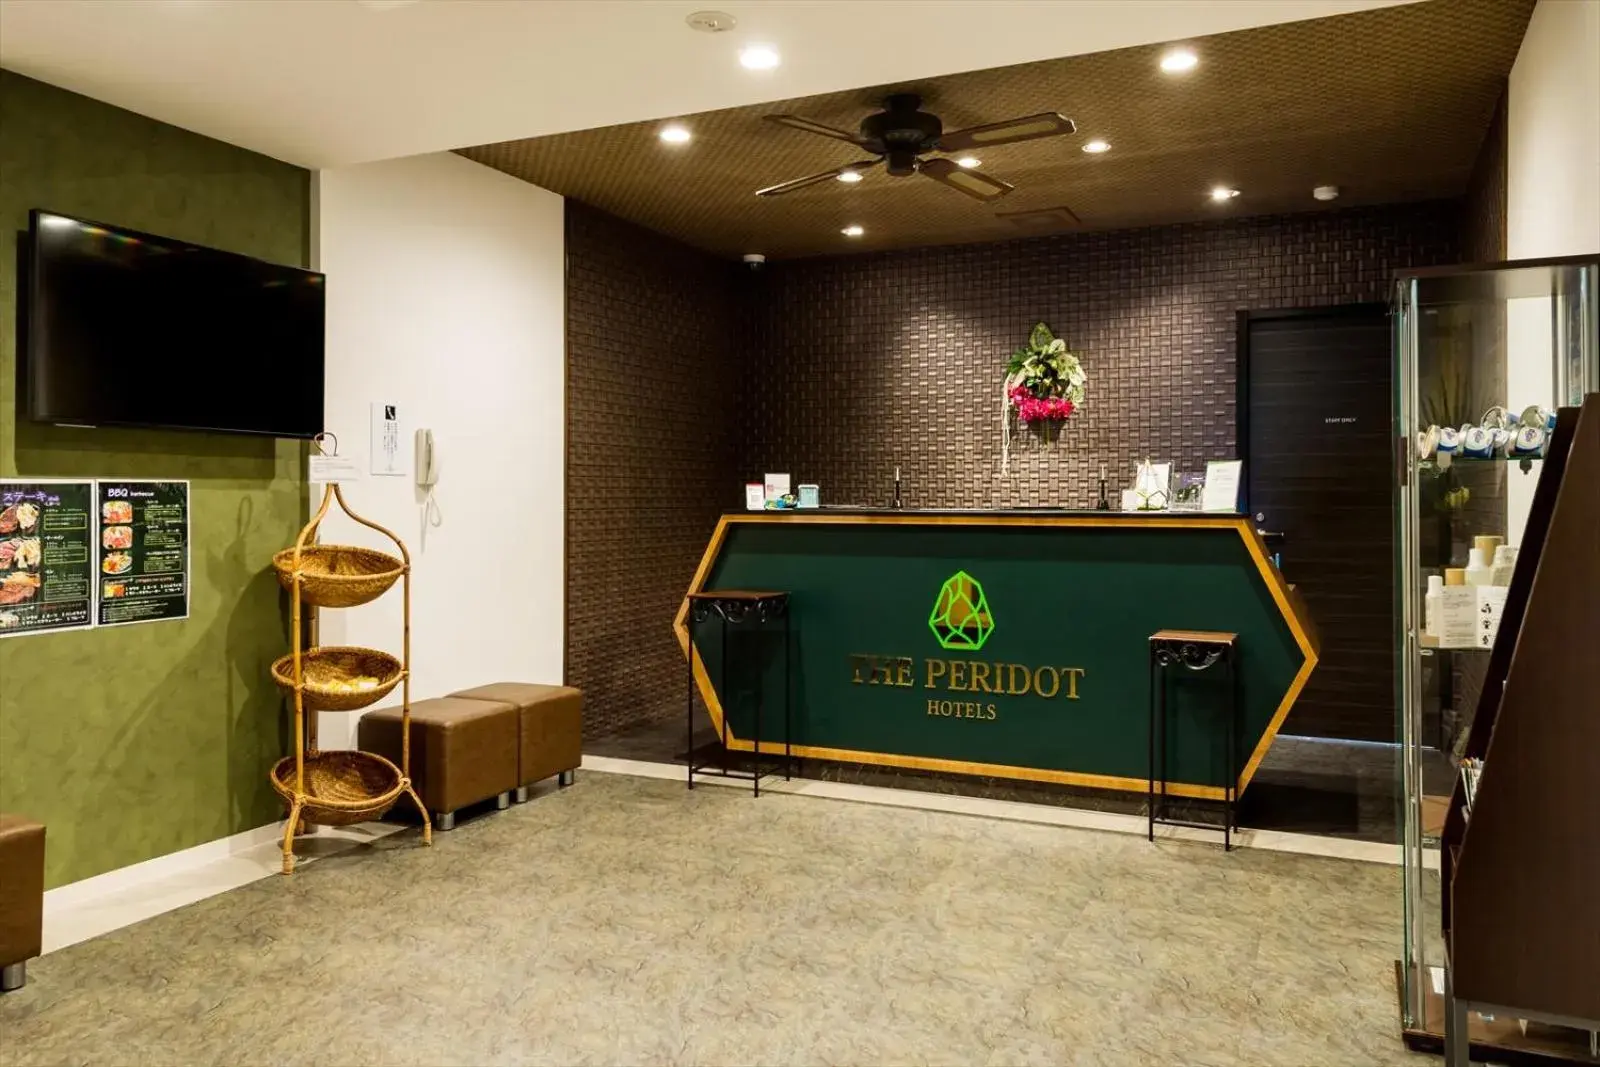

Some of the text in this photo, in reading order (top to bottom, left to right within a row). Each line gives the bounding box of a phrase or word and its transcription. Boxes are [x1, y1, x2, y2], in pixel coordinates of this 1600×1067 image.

[3, 491, 47, 502] ステーキ
[107, 488, 128, 497] BBQ
[850, 654, 1085, 699] THE PERIDOT
[927, 700, 996, 720] HOTELS
